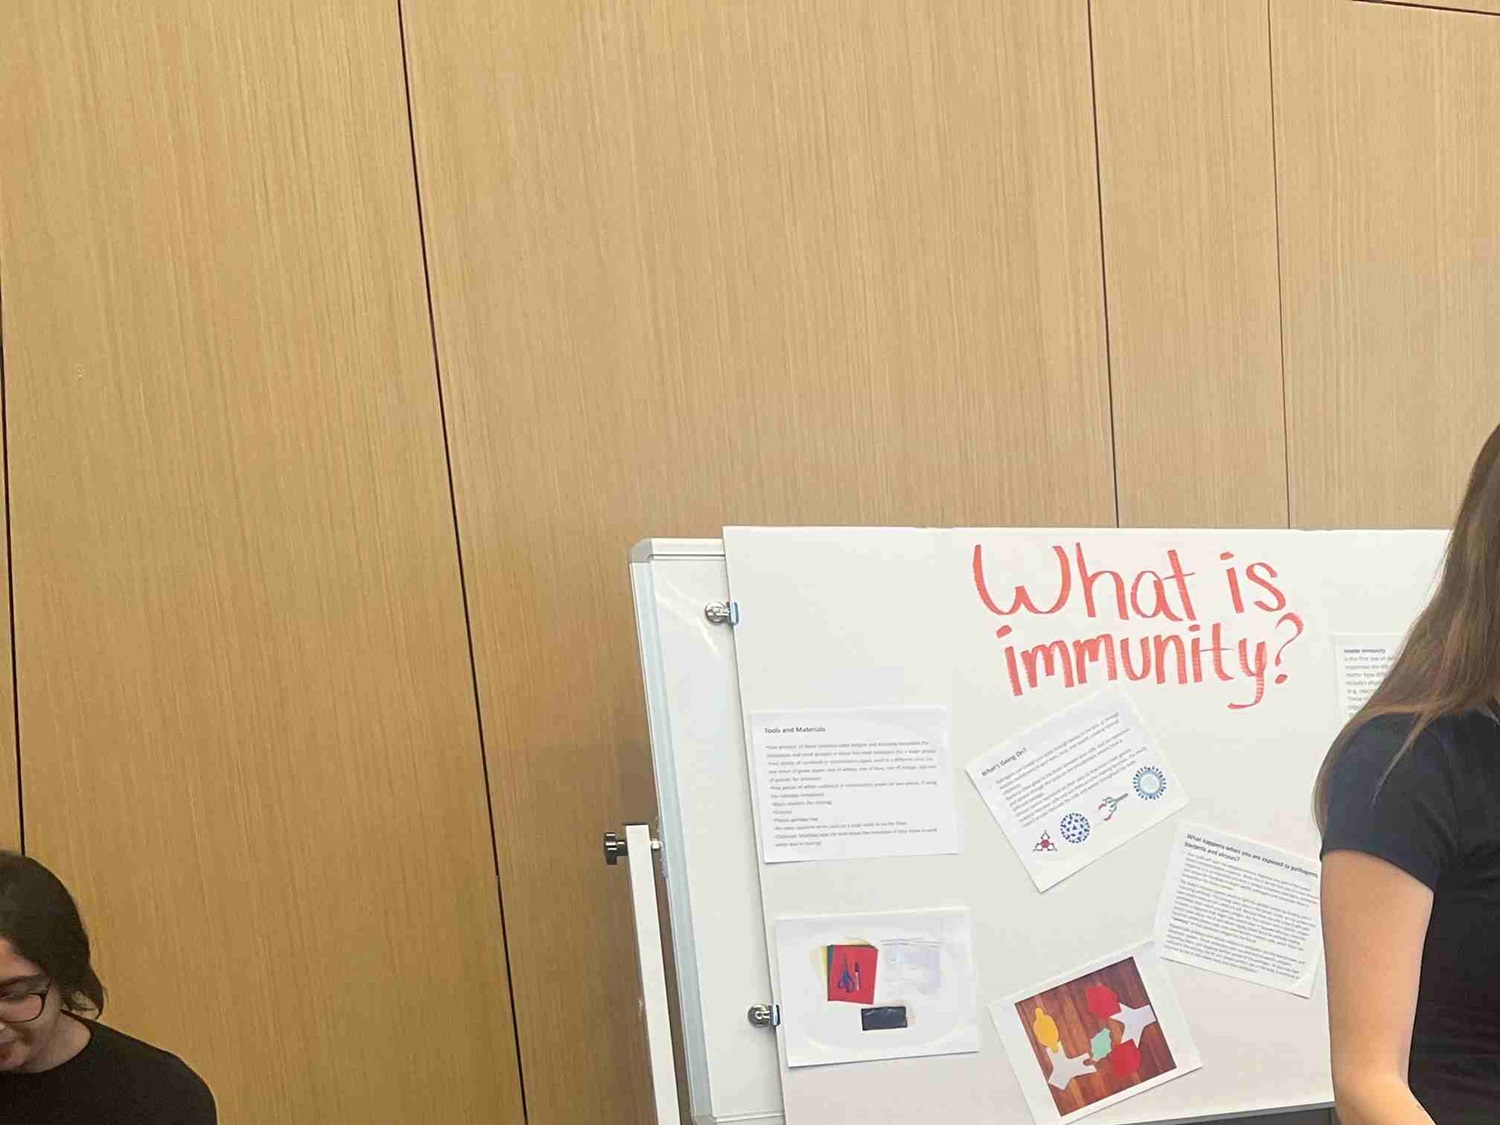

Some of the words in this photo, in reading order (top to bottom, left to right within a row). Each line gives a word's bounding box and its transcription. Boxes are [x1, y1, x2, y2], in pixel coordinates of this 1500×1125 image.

[972, 542, 1196, 622] What
[1219, 551, 1287, 614] is
[995, 612, 1304, 709] immunity?
[1186, 833, 1202, 843] What
[1225, 846, 1241, 854] when
